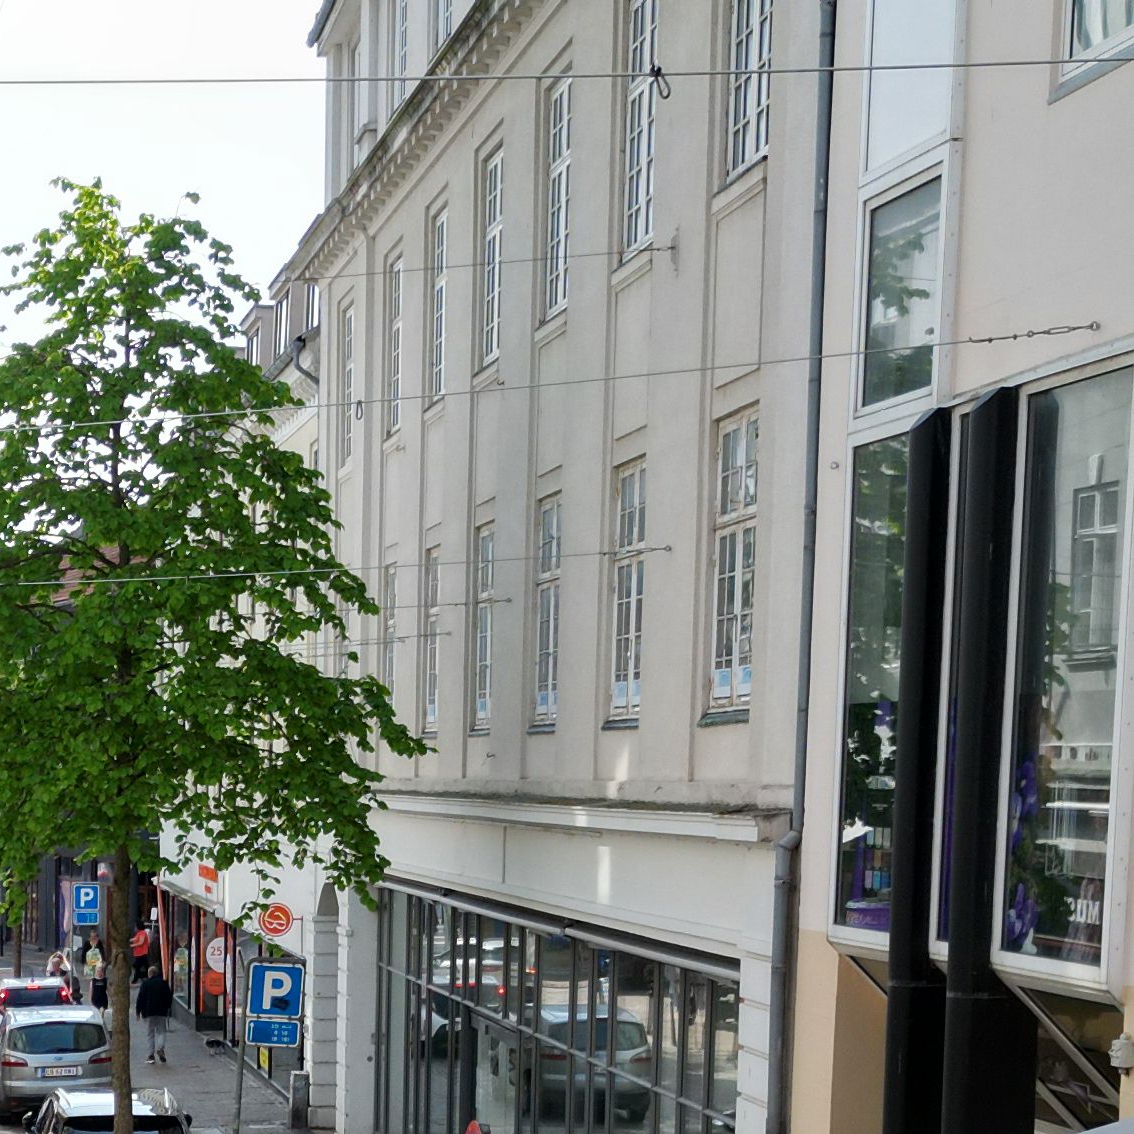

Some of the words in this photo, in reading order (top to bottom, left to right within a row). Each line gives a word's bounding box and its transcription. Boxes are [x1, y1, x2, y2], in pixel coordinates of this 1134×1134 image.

[80, 888, 94, 907] P
[210, 946, 223, 957] 25
[262, 970, 293, 1010] P
